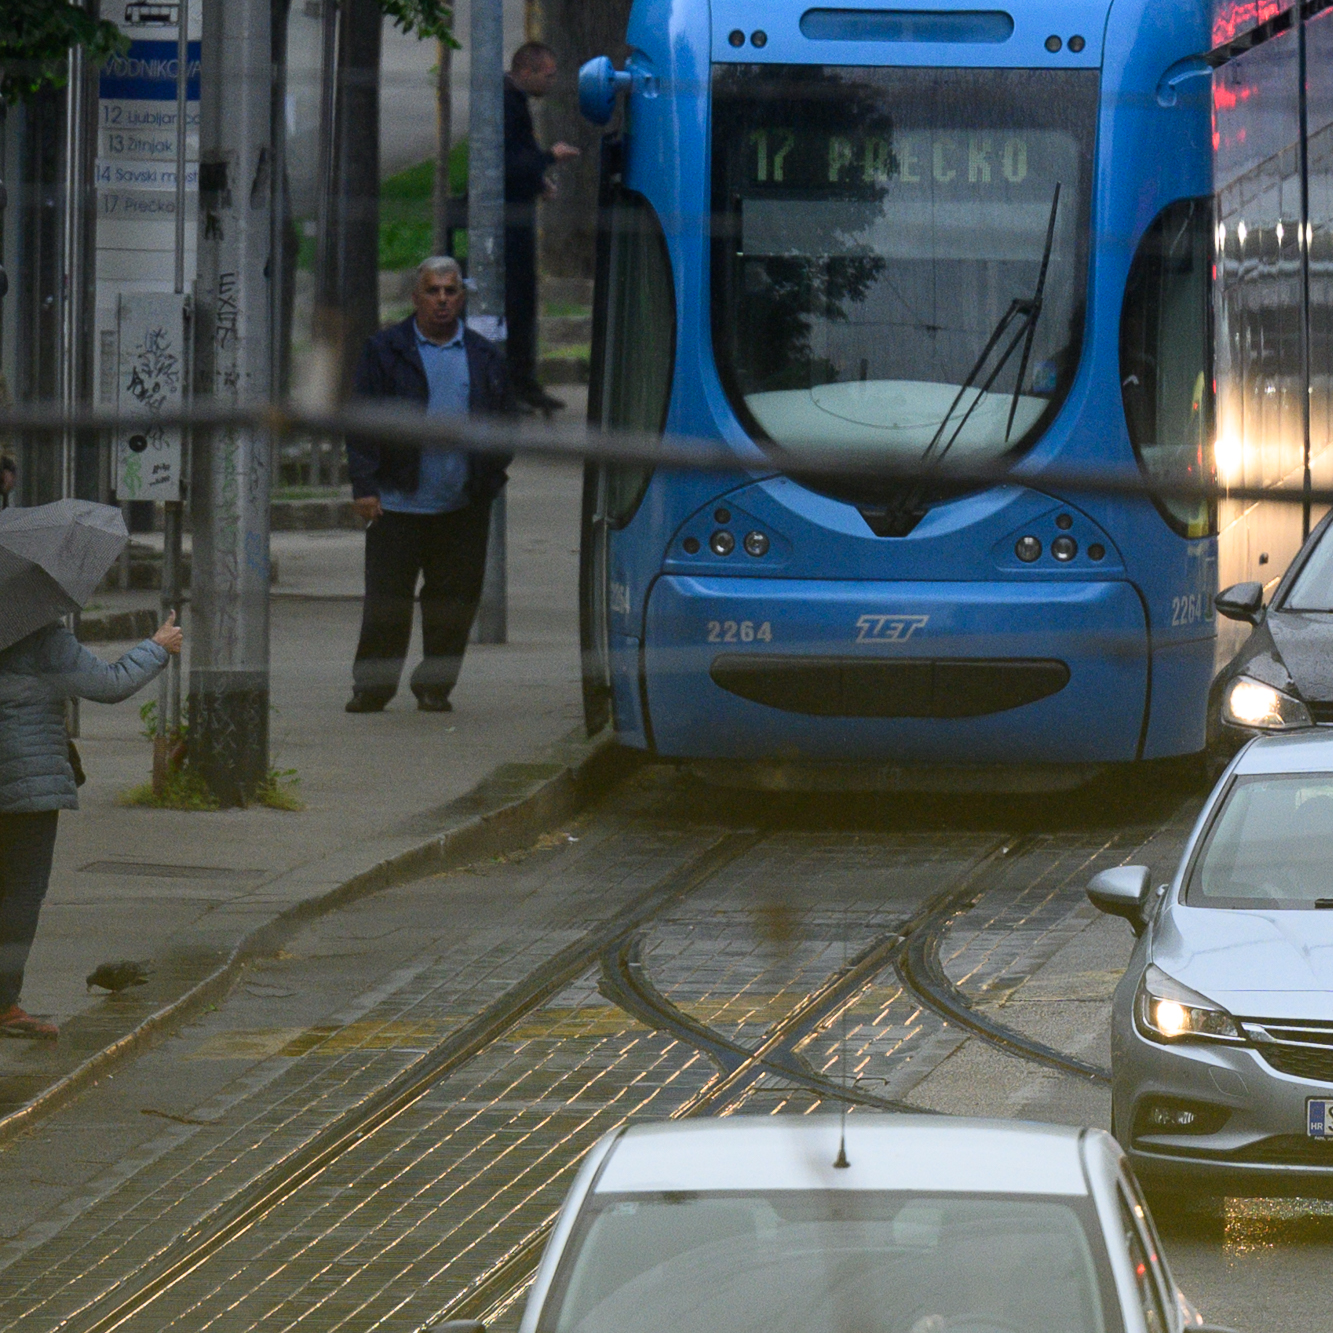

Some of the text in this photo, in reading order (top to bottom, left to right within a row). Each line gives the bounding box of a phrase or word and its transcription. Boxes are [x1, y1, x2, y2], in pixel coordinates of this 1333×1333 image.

[104, 106, 122, 124] 12
[109, 134, 124, 153] 13
[751, 128, 796, 182] 17
[161, 170, 198, 183] mst
[105, 195, 118, 213] 17
[1172, 593, 1202, 626] 2264
[708, 620, 773, 643] 2264
[1310, 1123, 1324, 1131] HR
